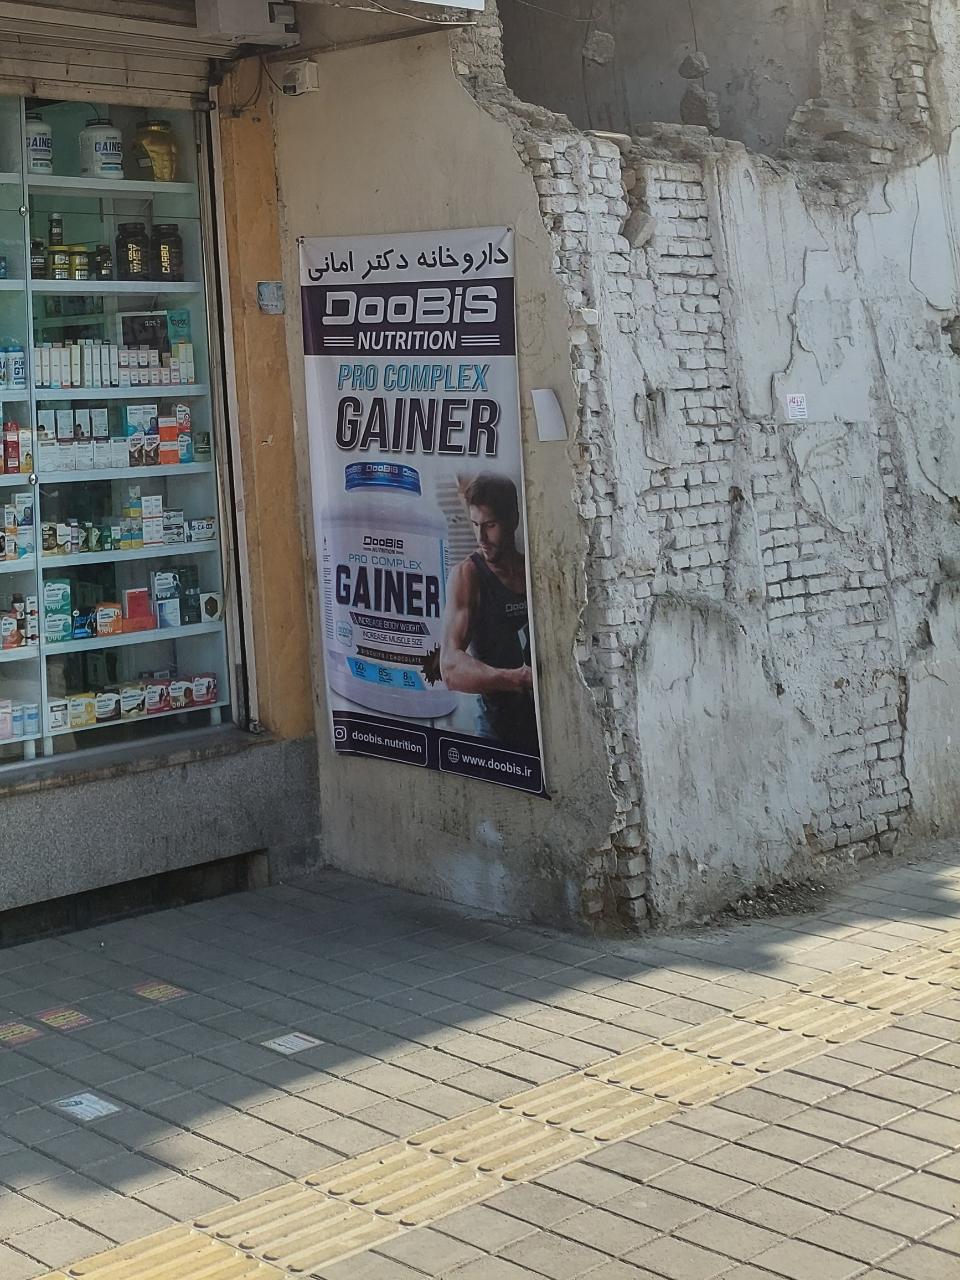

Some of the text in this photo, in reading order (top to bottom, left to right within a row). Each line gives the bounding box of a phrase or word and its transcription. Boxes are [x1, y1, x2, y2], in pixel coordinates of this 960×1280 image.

[160, 244, 171, 273] CARBO
[307, 242, 509, 281] داروخانه دکتر امانی
[357, 330, 457, 350] NUTRITION
[337, 364, 490, 392] PRO COMPLEX
[336, 395, 502, 456] GAINER
[348, 553, 423, 570] PRO COMPLEX
[335, 564, 440, 618] GAINER
[358, 616, 420, 633] INCREASE BODY WEIGHT
[362, 630, 423, 646] INCREASE MUSCLE SIZE
[352, 730, 423, 753] doobis.nutrition
[461, 753, 532, 777] www.doobis.ir
